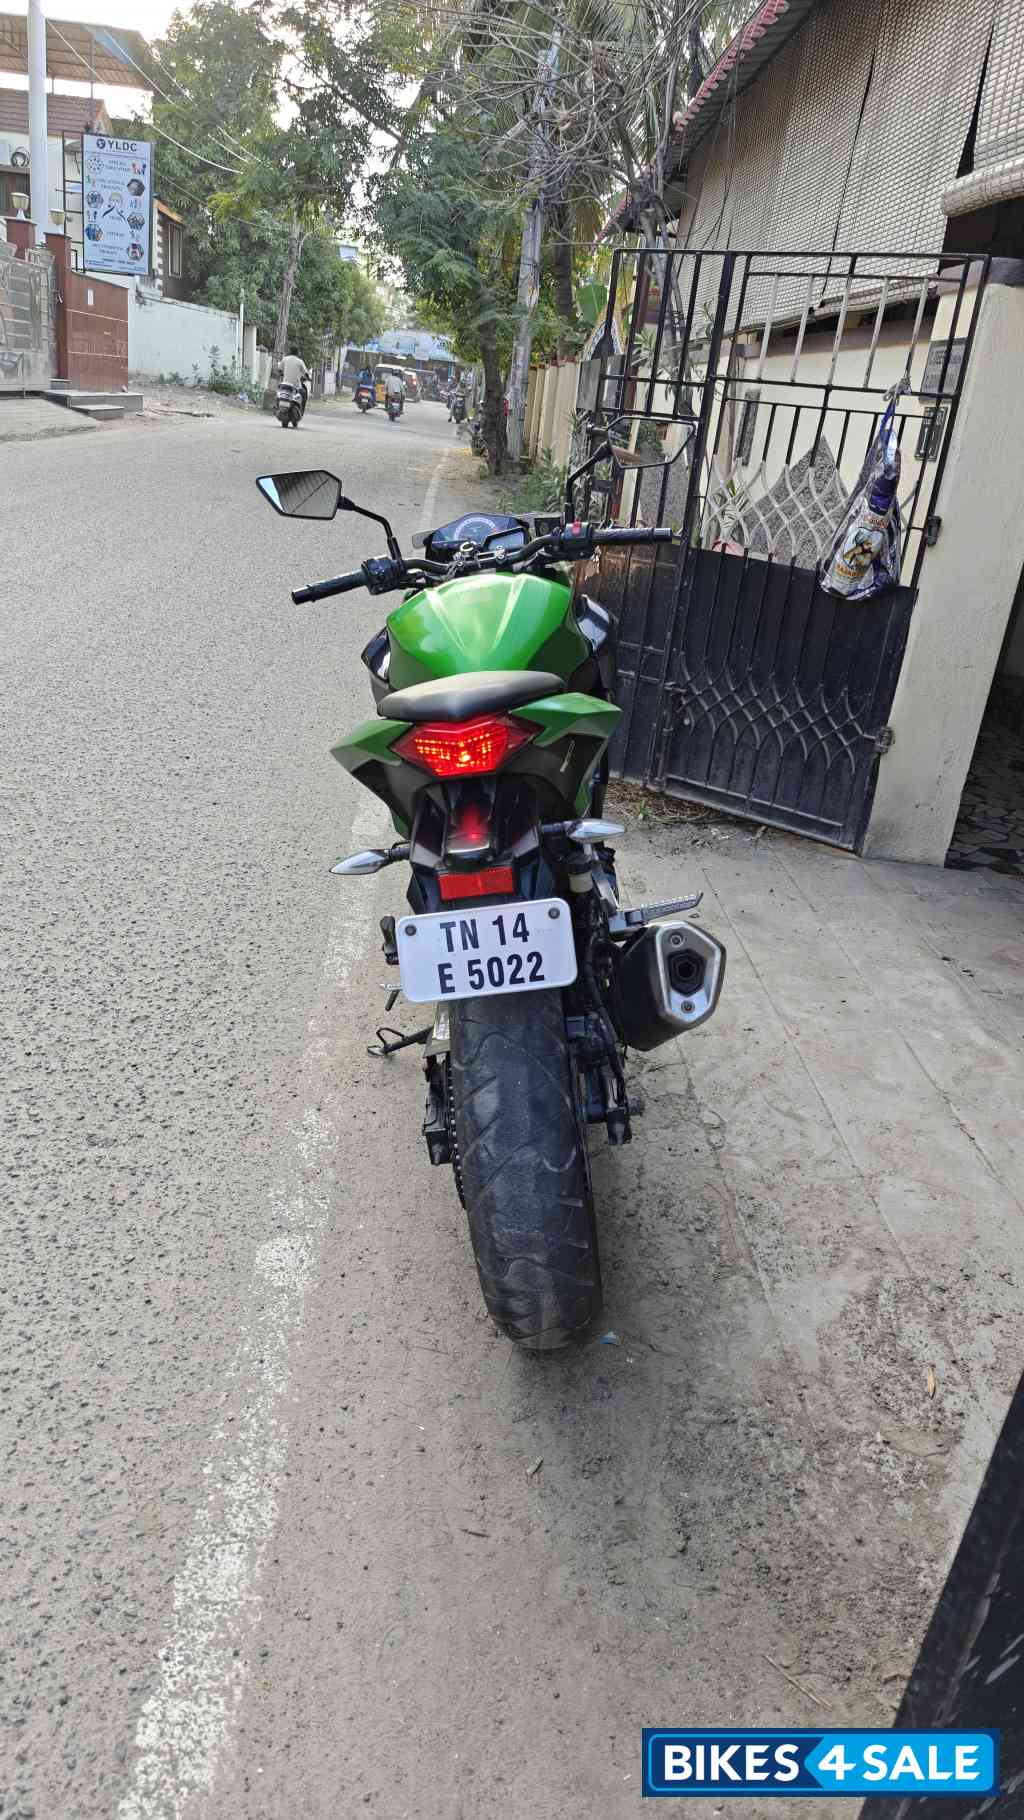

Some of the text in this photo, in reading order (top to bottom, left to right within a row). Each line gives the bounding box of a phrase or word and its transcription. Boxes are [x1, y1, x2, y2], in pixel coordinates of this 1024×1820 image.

[108, 141, 137, 152] YLDC
[439, 912, 530, 952] TN 14
[437, 951, 545, 994] E 5022
